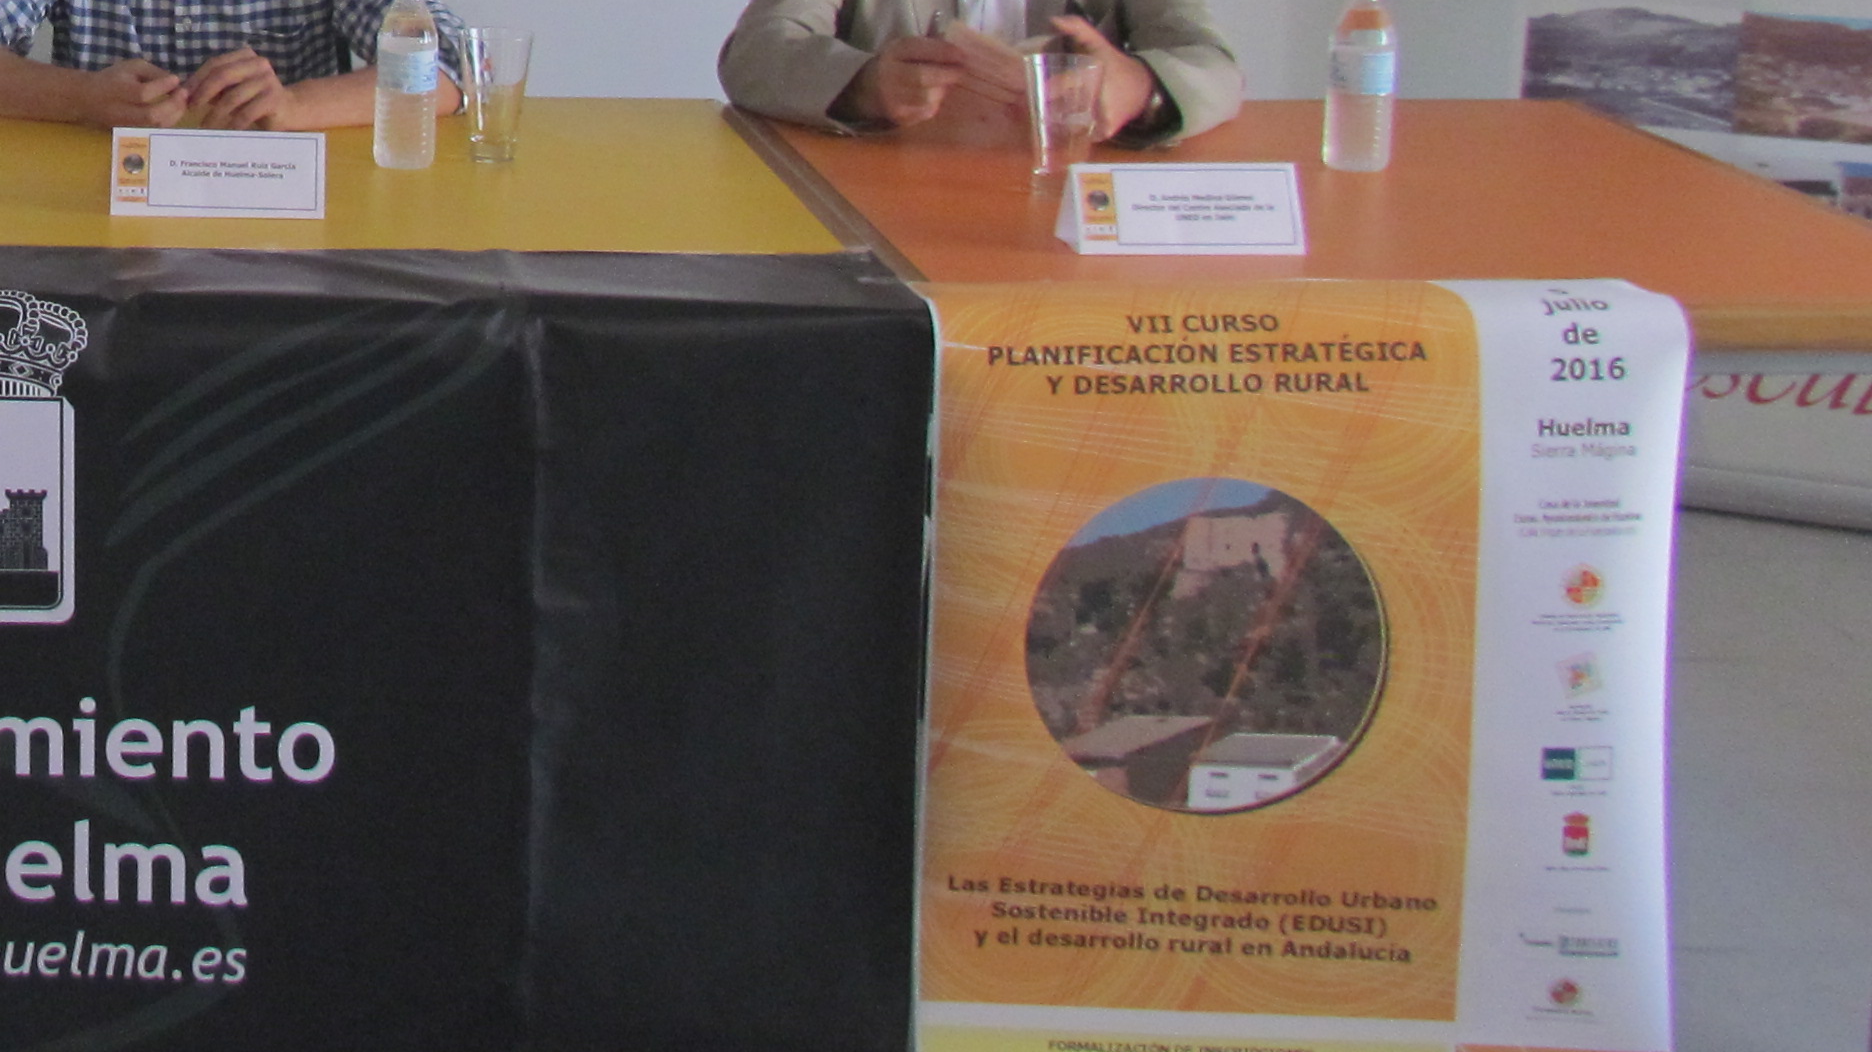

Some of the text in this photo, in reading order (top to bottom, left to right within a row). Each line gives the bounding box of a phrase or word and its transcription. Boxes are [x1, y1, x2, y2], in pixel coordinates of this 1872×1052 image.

[1540, 297, 1609, 315] julio
[1127, 314, 1279, 334] VII CURSO
[1562, 322, 1599, 345] de
[988, 335, 1427, 366] PLANIFICACIÓN ESTRATÉGICA
[1551, 357, 1625, 382] 2016
[1046, 372, 1369, 395] Y DESARROLLO RURAL
[1538, 418, 1630, 437] Huelma
[1531, 443, 1575, 459] Sierra
[949, 875, 1438, 912] Las Estrategias de Desarrollo Urbano
[992, 901, 1387, 938] Sostenible Integrado (EDUSI)
[974, 926, 1412, 963] y el desarrollo rural en Andalucía
